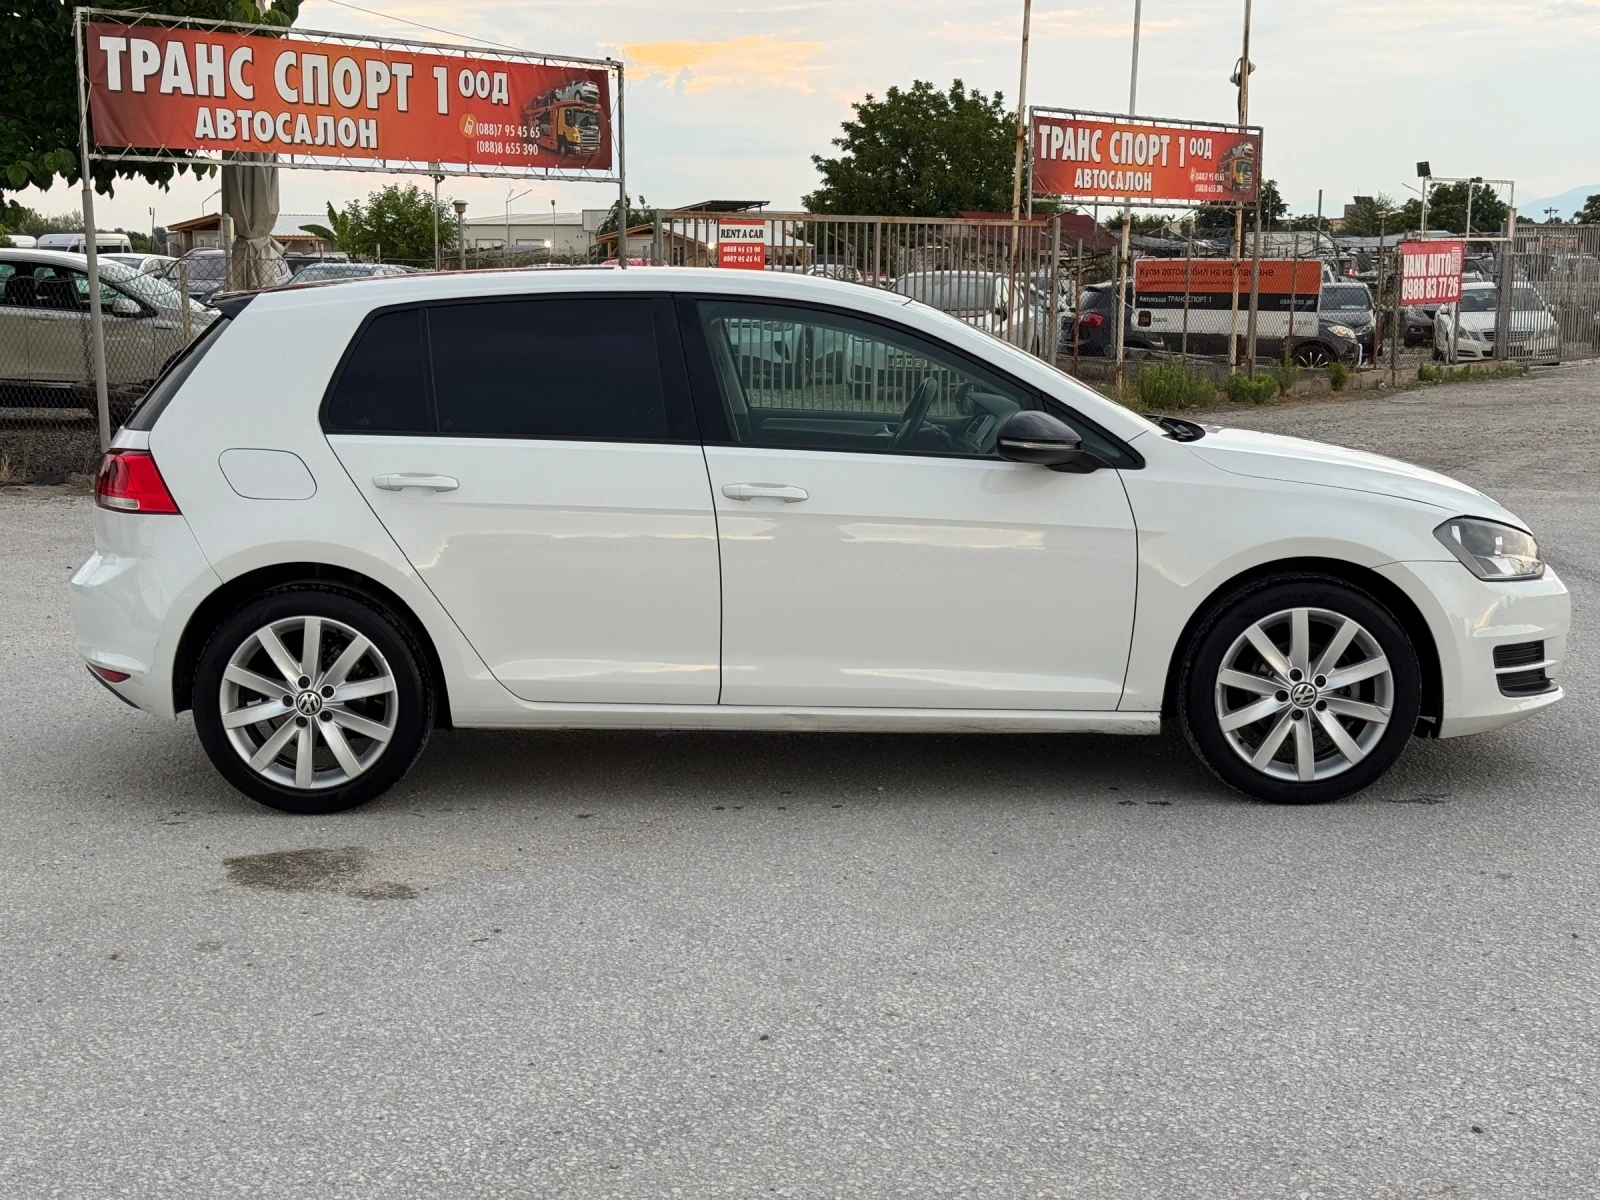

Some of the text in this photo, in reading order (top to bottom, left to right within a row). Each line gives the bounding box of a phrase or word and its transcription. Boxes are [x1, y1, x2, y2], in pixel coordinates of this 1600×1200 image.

[99, 35, 509, 115] ТРАНС СПОРТ 1 ООД
[195, 106, 378, 149] АВТОСАЛОН
[476, 122, 540, 139] (088)7 95 45 65
[476, 140, 539, 156] (088)8 655 390
[1039, 124, 1213, 168] ТРАНС СПОРТ 1 ООД
[1073, 168, 1152, 192] АВТОСАЛОН
[720, 229, 764, 239] RENT A CAR
[723, 245, 737, 253] 0888
[1140, 267, 1160, 278] Купи
[1211, 268, 1221, 276] на
[1403, 252, 1451, 278] VANK AUTO
[1402, 276, 1459, 301] 0988 83 77 26
